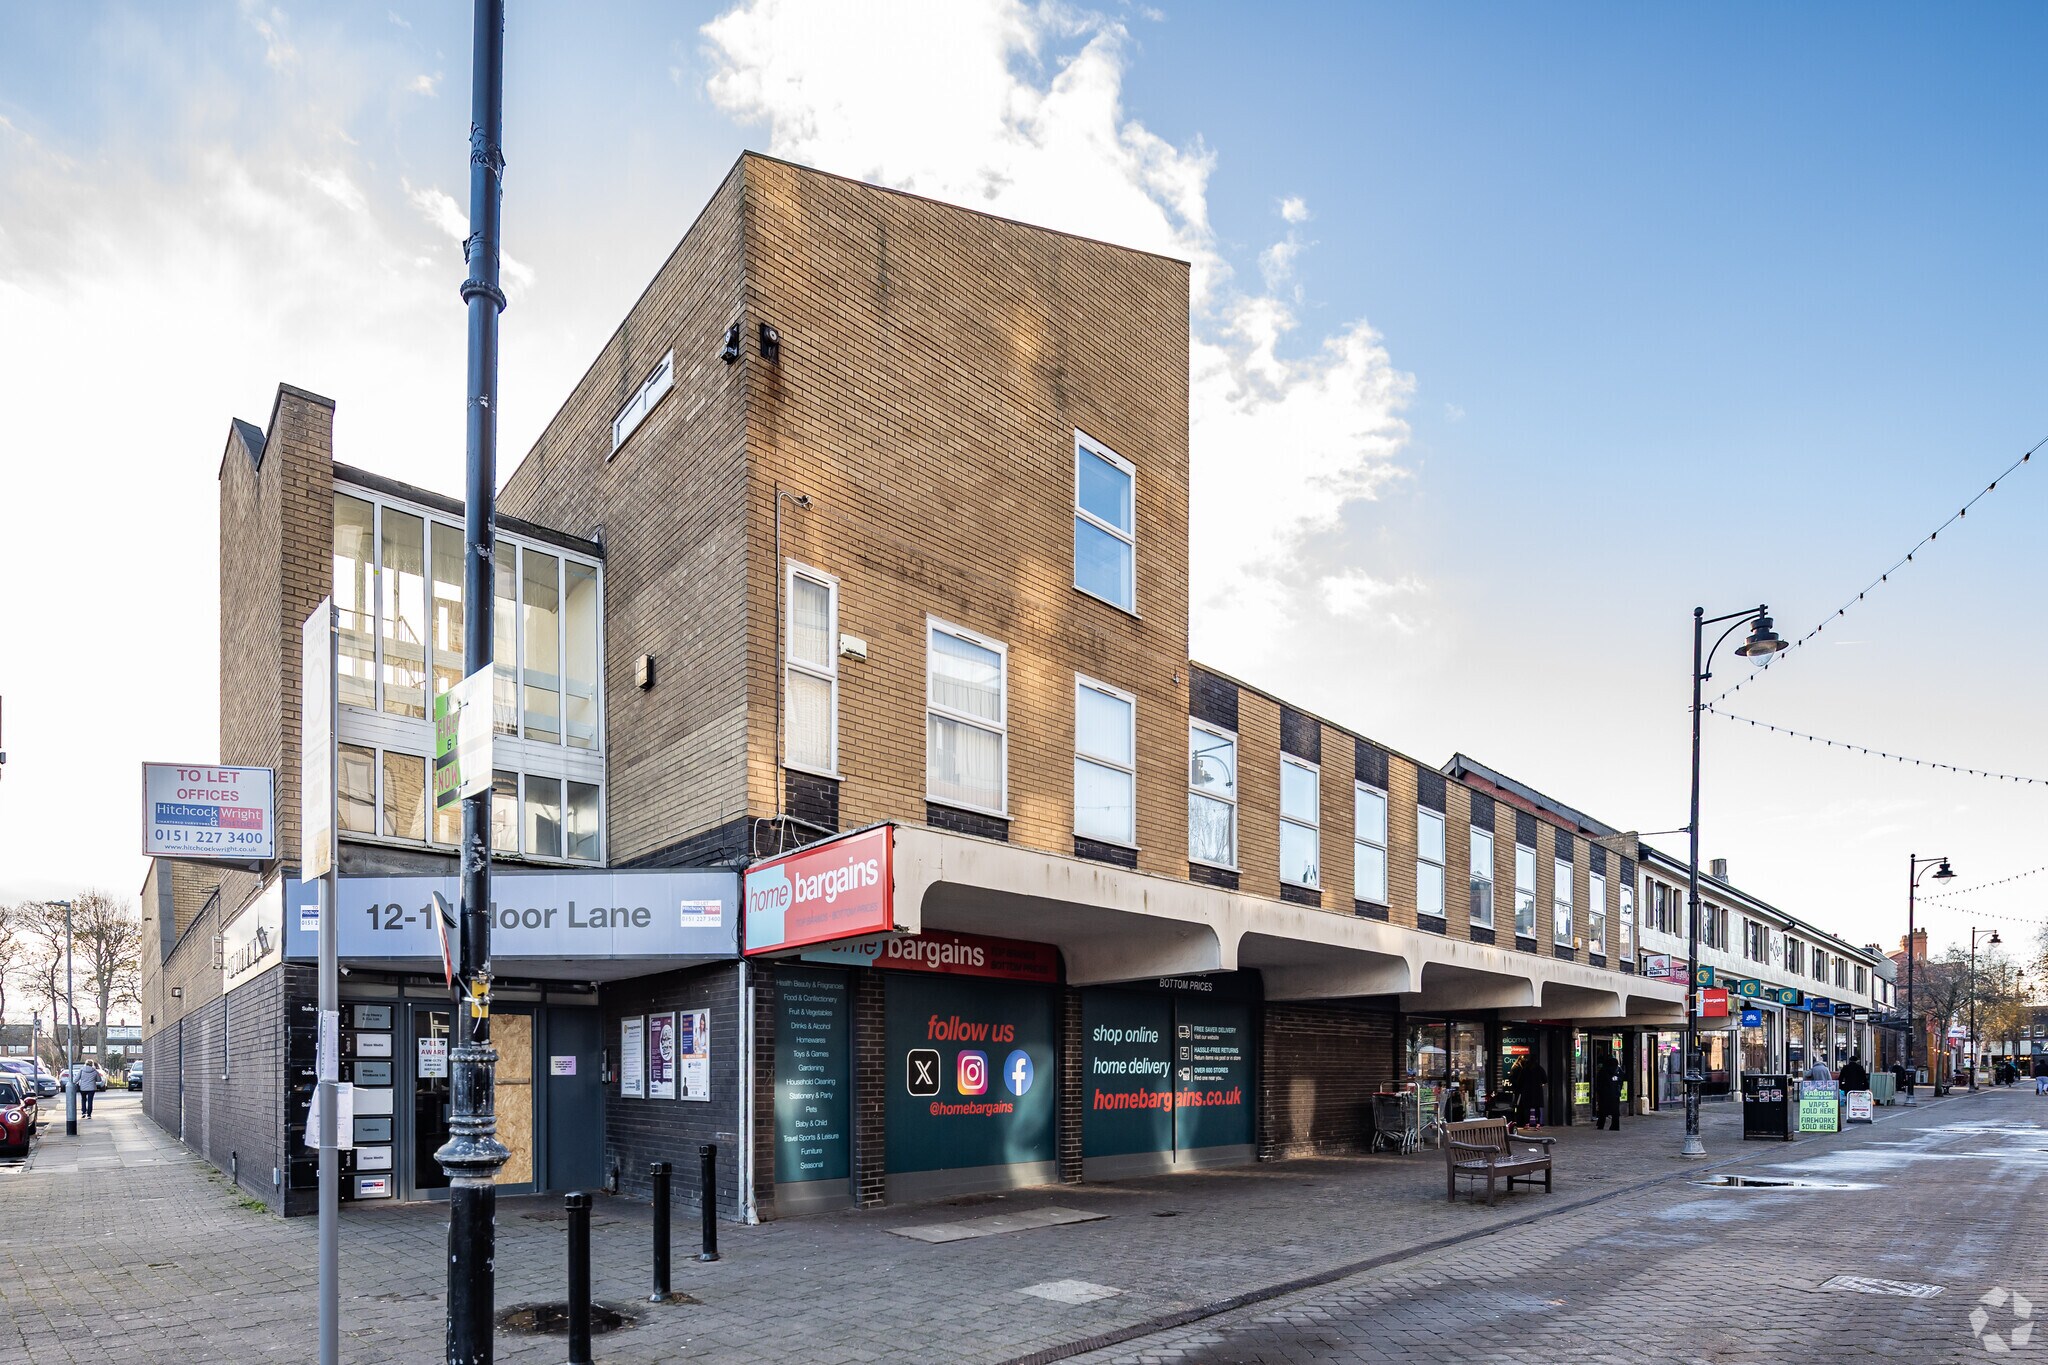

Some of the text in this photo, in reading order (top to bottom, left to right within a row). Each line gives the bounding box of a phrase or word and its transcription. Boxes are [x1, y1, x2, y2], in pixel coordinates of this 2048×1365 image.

[177, 769, 240, 783] TO LET
[177, 788, 239, 801] OFFICES
[157, 804, 261, 821] Hitchcock Wright
[210, 817, 261, 828] & Partners
[155, 829, 263, 844] 0151 227 3400
[165, 843, 257, 853] www.hitchcockwright.co.uk
[749, 857, 878, 913] home bargains
[367, 903, 454, 930] 12-1
[568, 901, 651, 928] Lane
[888, 936, 985, 968] bargains
[776, 979, 793, 987] Health
[793, 980, 811, 988] Beauty
[817, 981, 844, 990] Fragrances
[1159, 978, 1213, 991] BOTTOM PRICES
[803, 994, 837, 1003] Confectionery
[805, 1009, 832, 1017] Vegetables
[791, 1022, 807, 1030] Drinks
[928, 1015, 1015, 1043] follow us
[1093, 1025, 1158, 1046] shop online
[793, 1050, 805, 1058] Toys
[798, 1064, 824, 1072] Gardening
[1093, 1057, 1170, 1078] home delivery
[814, 1078, 836, 1086] Cleaning
[789, 1092, 815, 1100] Stationery
[1093, 1086, 1241, 1113] homebargains.co.uk
[930, 1101, 1013, 1117] @homebargains
[796, 1120, 809, 1128] Baby
[799, 1134, 815, 1142] Sports
[800, 1160, 823, 1169] Seasonal
